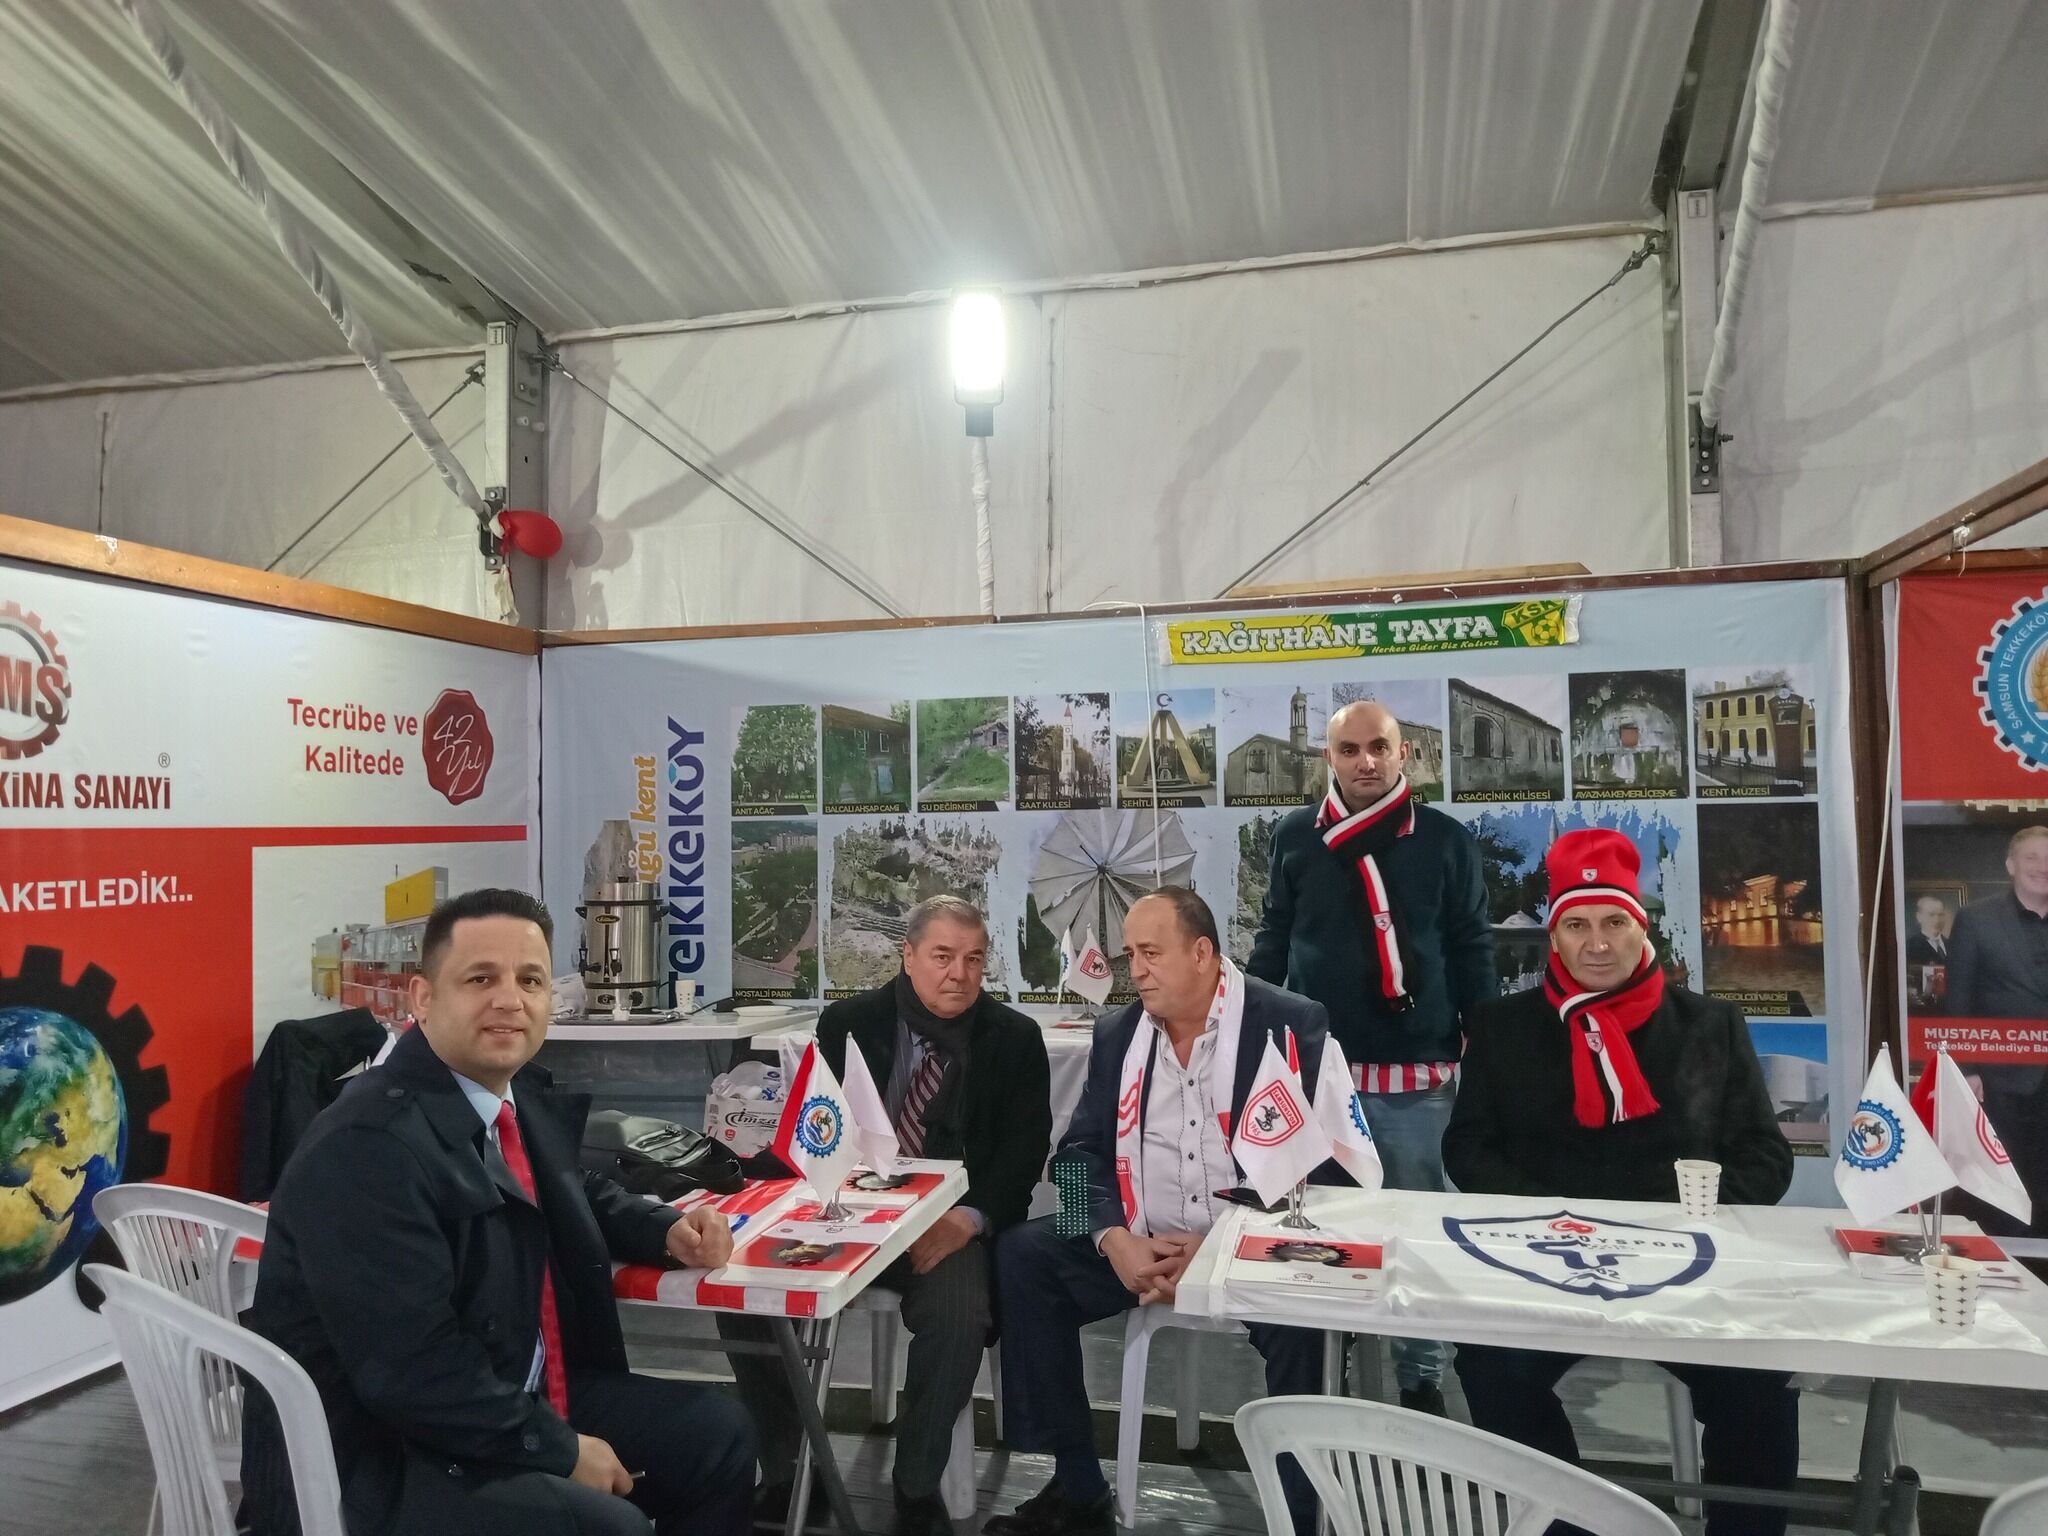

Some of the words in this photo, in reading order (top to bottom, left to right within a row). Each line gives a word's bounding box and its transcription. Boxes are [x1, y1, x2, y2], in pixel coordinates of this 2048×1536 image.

[1181, 621, 1378, 655] KAĞITHANE
[1388, 615, 1498, 644] TAYFA
[2000, 613, 2048, 668] TEKKEKÖ
[1371, 645, 1406, 654] Herkes
[1408, 643, 1438, 652] Gider
[1441, 641, 1458, 650] Biz
[1998, 674, 2022, 728] SAMSUN
[287, 698, 386, 733] Tecrübe
[394, 715, 418, 735] ve
[433, 714, 474, 746] 42
[305, 745, 405, 775] Kalitede
[630, 756, 657, 823] kent
[1512, 789, 1551, 800] KİLİSESİ
[1702, 788, 1729, 796] KENT
[1731, 785, 1770, 796] MÜZESİ
[1020, 801, 1041, 809] SAAT
[1042, 799, 1071, 808] KULESİ
[1160, 799, 1182, 807] ANITI
[1270, 794, 1304, 805] KİLİSESİ
[754, 807, 775, 816] AĞAÇ
[933, 802, 978, 811] DEĞİRMENİ
[771, 990, 792, 998] PARK
[1924, 1027, 2001, 1040] MUSTAFA
[1981, 1043, 2030, 1053] Belediye
